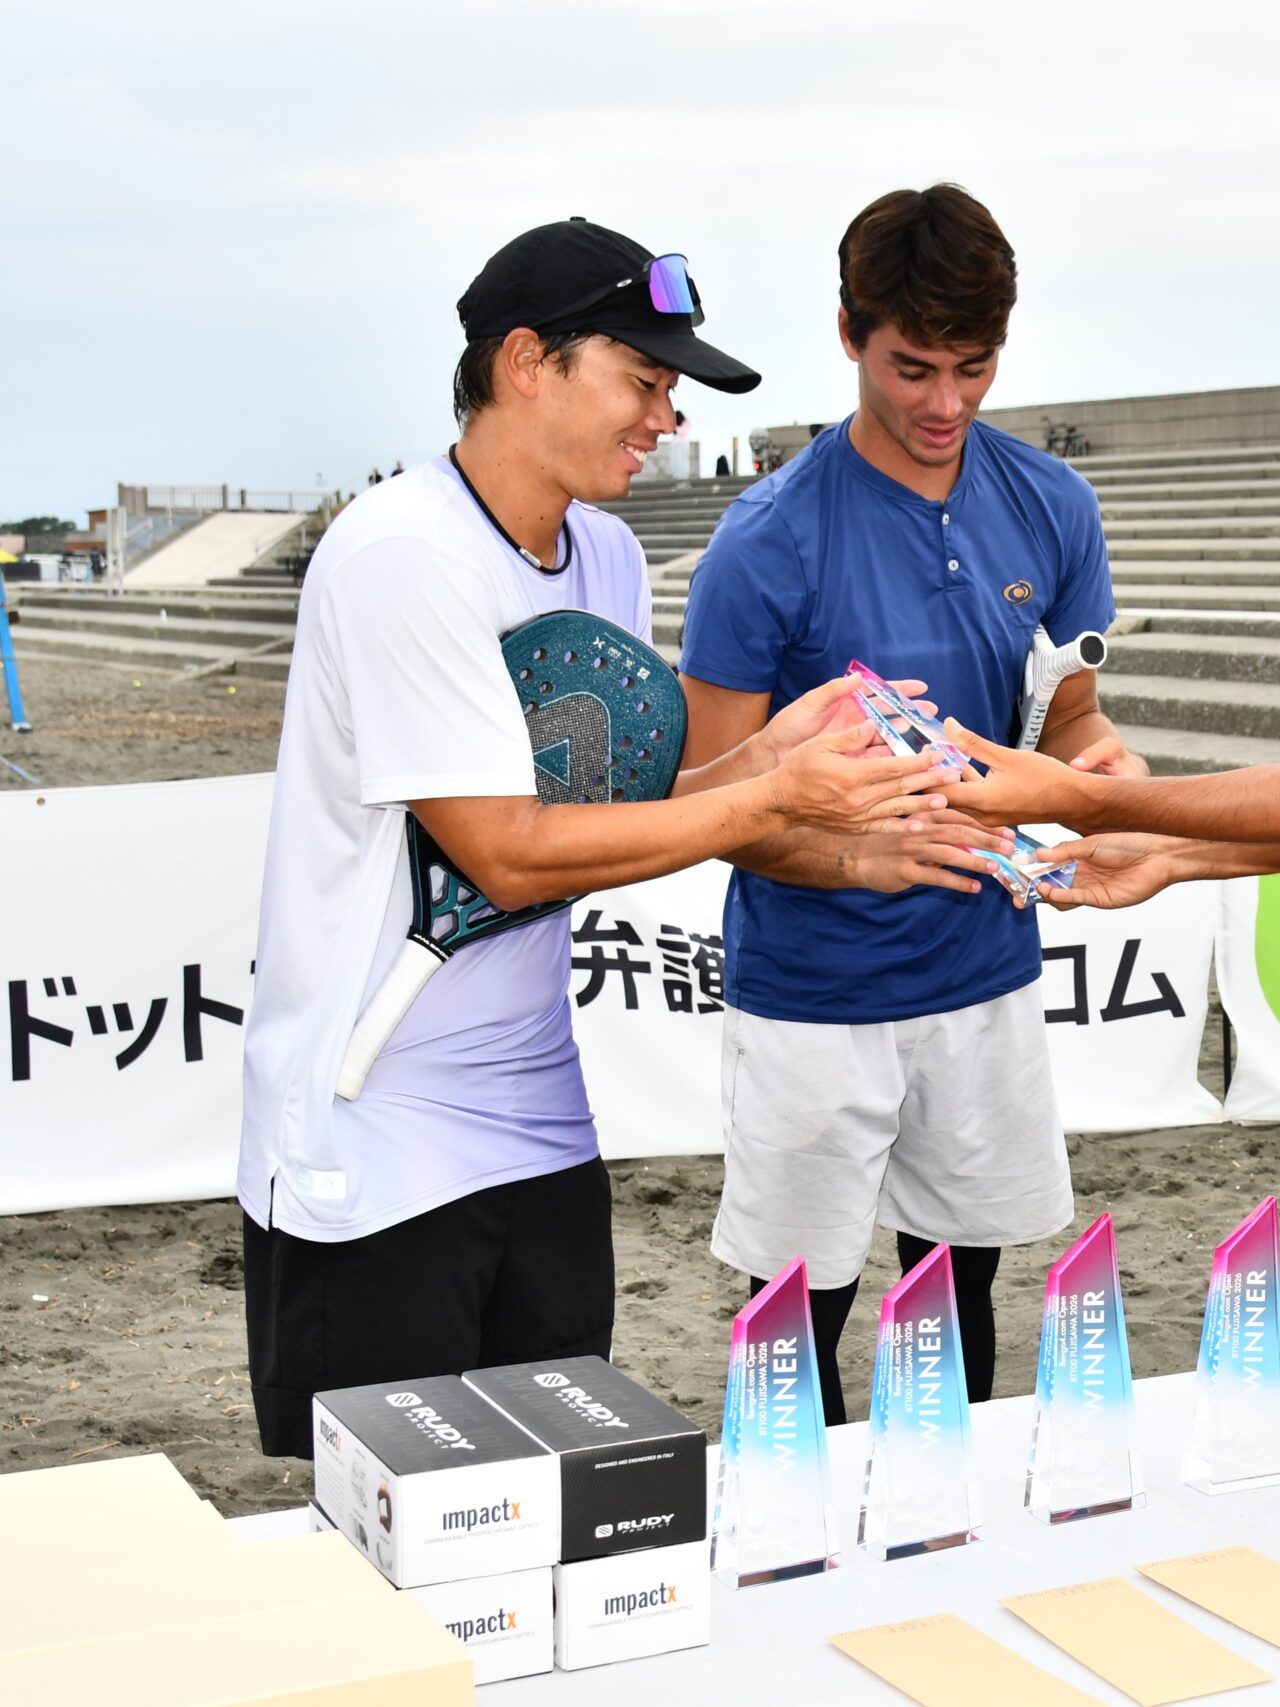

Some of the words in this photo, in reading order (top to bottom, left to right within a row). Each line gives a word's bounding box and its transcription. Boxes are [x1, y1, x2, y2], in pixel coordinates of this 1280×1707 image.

[571, 909, 725, 1014] 弁護
[1041, 938, 1186, 1026] コム
[8, 960, 255, 1082] ドット
[1224, 1274, 1233, 1296] Open
[1234, 1273, 1242, 1293] 2026
[1059, 1296, 1068, 1319] Open
[1070, 1294, 1078, 1315] 2026
[1232, 1295, 1241, 1334] FUJISAWA
[893, 1322, 903, 1346] Open
[904, 1321, 913, 1343] 2026
[1069, 1317, 1078, 1357] FUJISAWA
[1243, 1269, 1267, 1394] WINNER
[747, 1343, 757, 1368] Open
[758, 1341, 768, 1365] 2026
[904, 1345, 913, 1386] FUJISAWA
[1082, 1290, 1105, 1419] WINNER
[758, 1366, 768, 1409] FUJISAWA
[918, 1316, 942, 1449] WINNER
[554, 1392, 604, 1427] PROJECT
[561, 1386, 629, 1428] RUDY
[772, 1336, 799, 1473] WINNER
[404, 1412, 450, 1449] PROJECT
[410, 1406, 476, 1450] RUDY
[595, 1461, 618, 1469] DESIGNED
[442, 1498, 521, 1532] impactx
[617, 1513, 675, 1531] RUDY
[622, 1522, 670, 1534] PROJECT
[604, 1582, 677, 1616] impactx
[444, 1608, 517, 1642] mpactx
